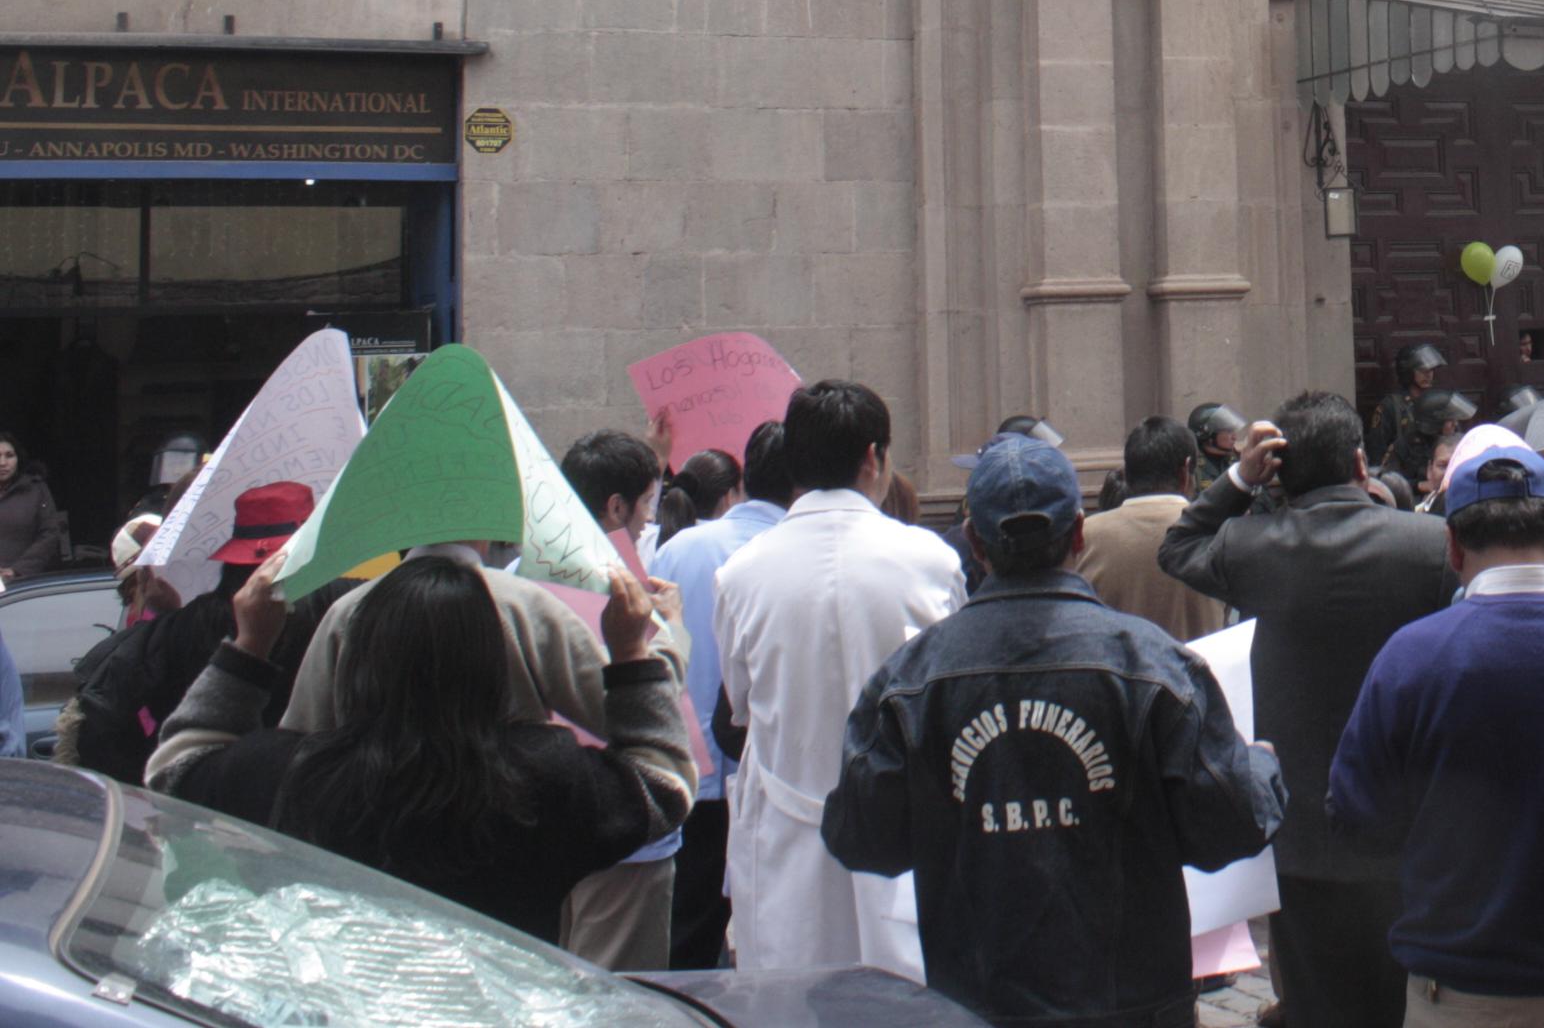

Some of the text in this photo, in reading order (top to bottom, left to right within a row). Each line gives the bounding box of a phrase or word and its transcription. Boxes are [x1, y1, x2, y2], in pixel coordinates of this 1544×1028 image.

[0, 50, 431, 114] ALPACA INTERNATIONAL
[28, 141, 167, 158] ANNAPOLIS
[173, 142, 213, 158] MD
[229, 143, 388, 160] WASHINGTON
[393, 144, 424, 160] DC
[951, 699, 1116, 803] SERVICIOS FUNERARIOS
